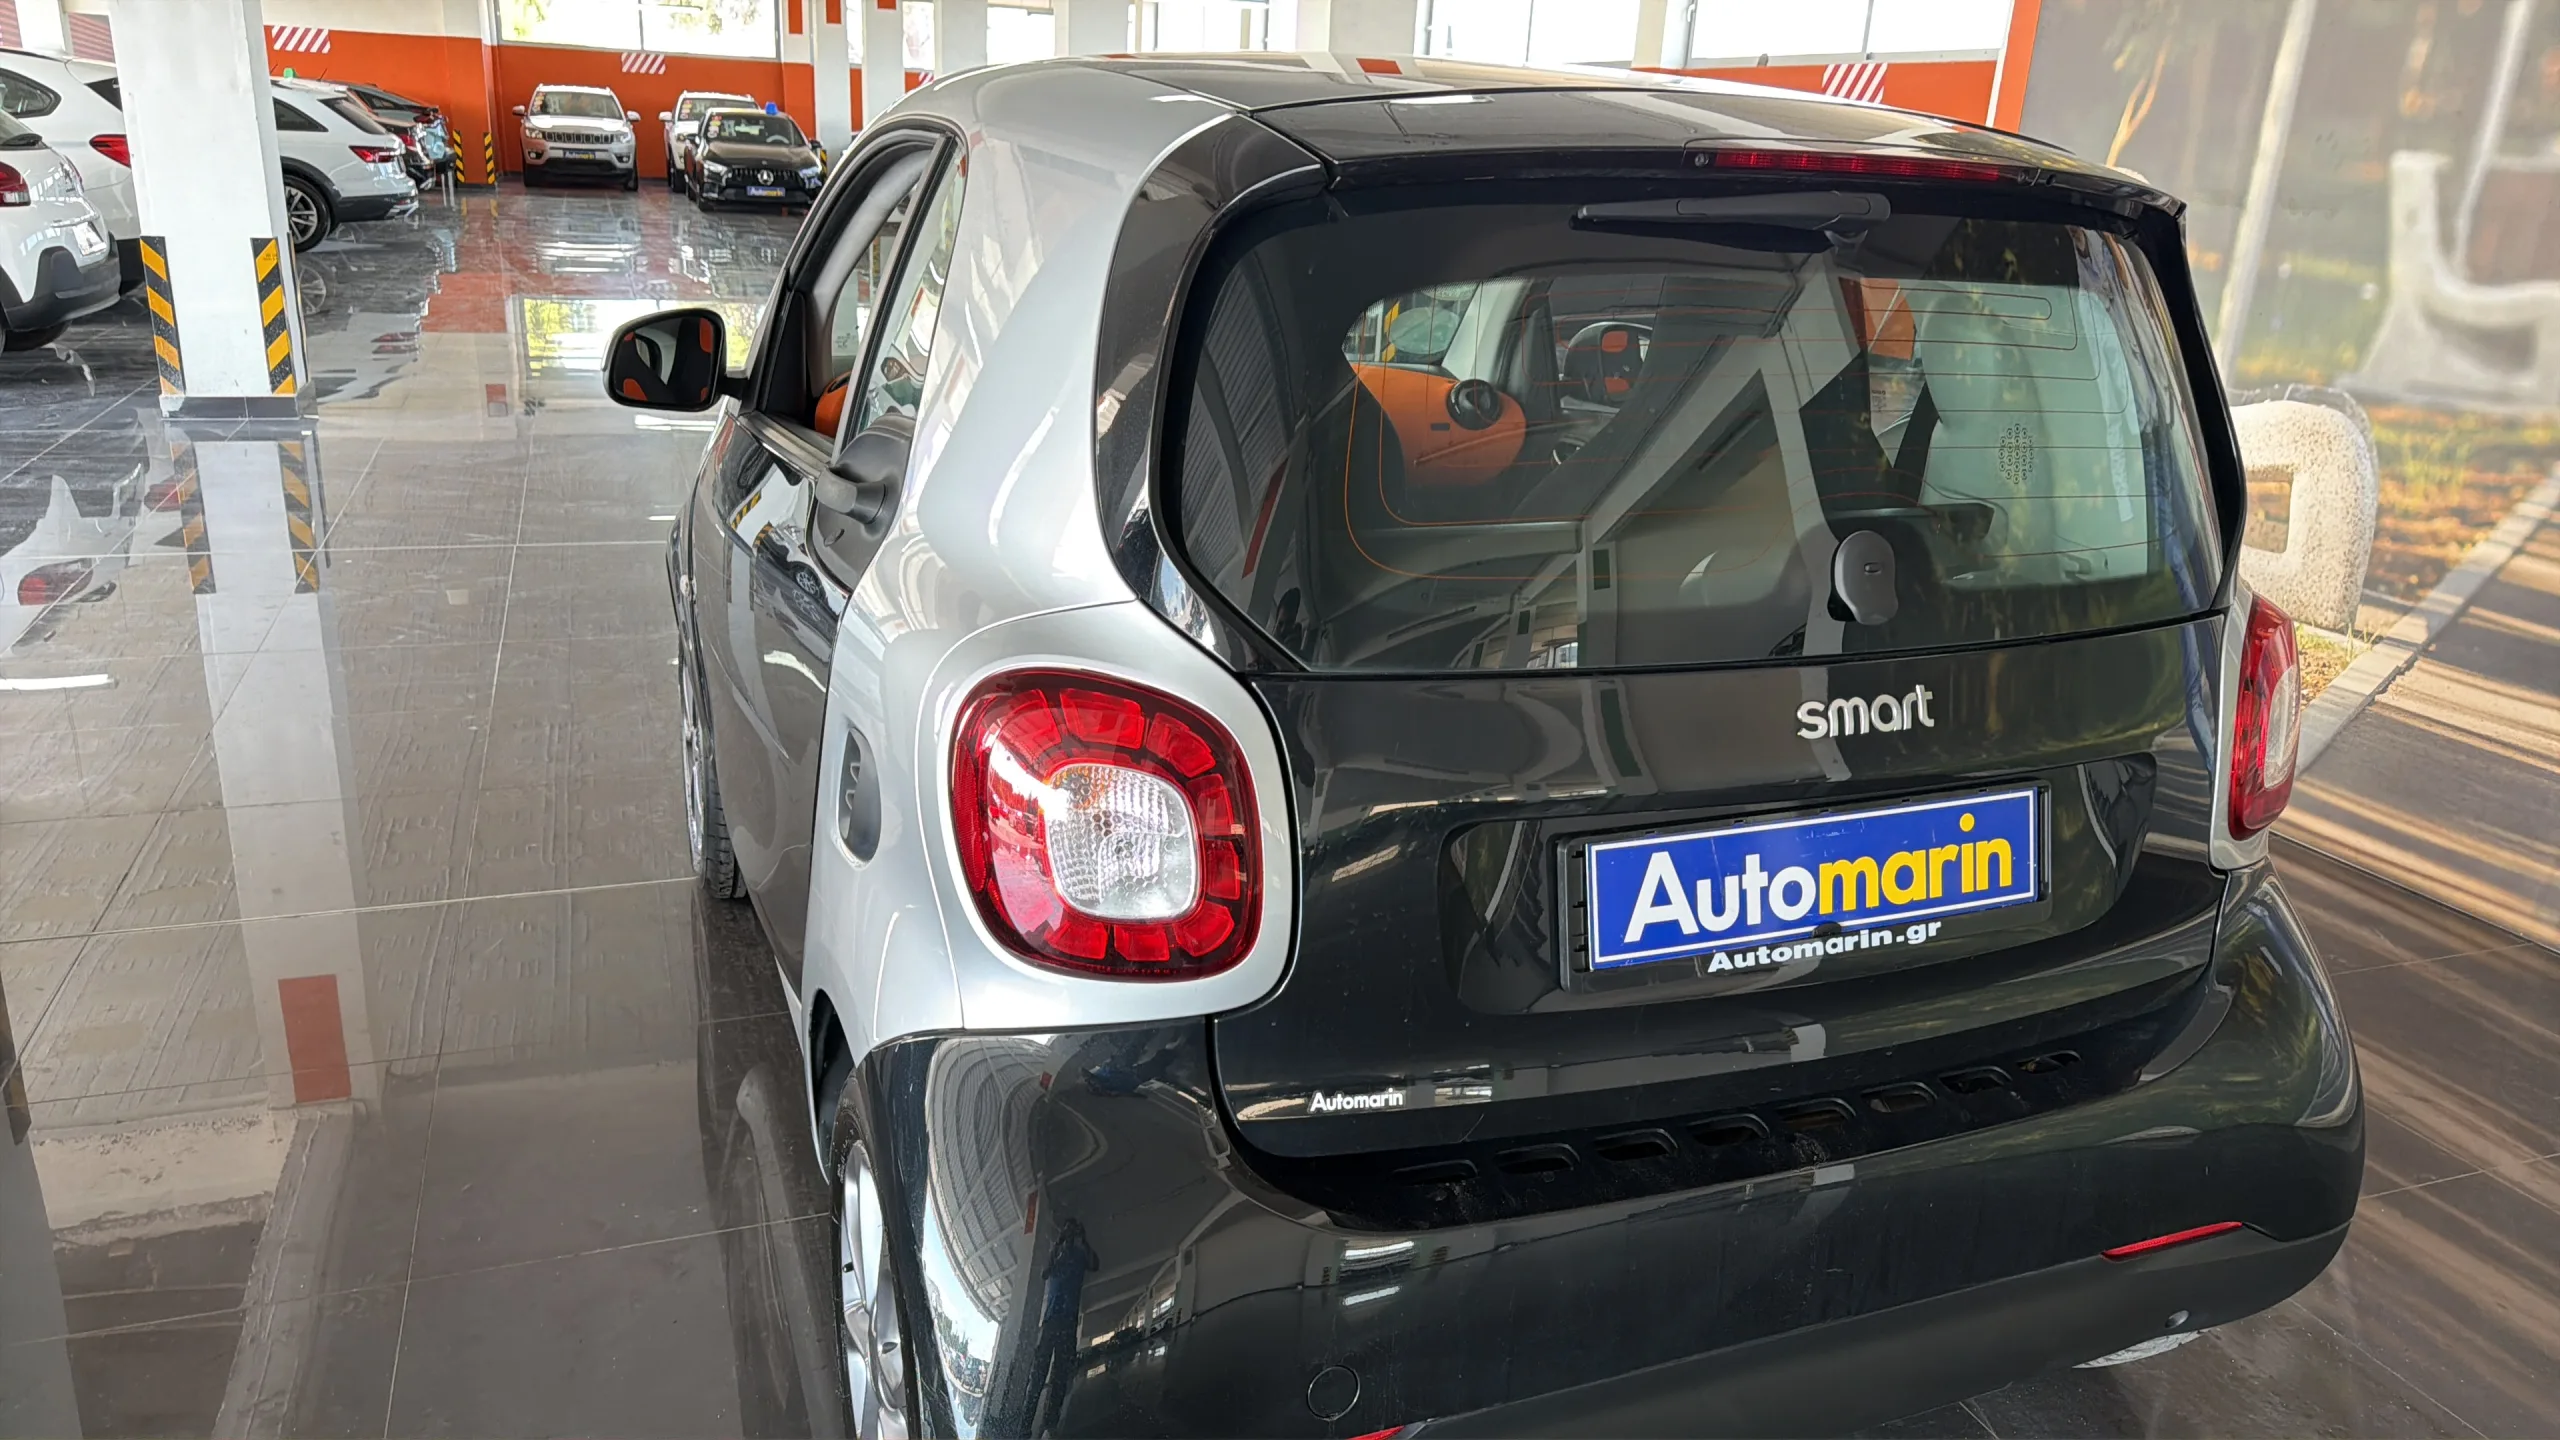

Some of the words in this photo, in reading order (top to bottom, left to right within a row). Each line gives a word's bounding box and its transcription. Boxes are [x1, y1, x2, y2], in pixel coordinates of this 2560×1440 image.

[1796, 684, 1935, 740] smart
[1624, 813, 2012, 943] Automarin
[1707, 920, 1941, 973] Automarin.gr
[1310, 1087, 1404, 1112] Automarin
